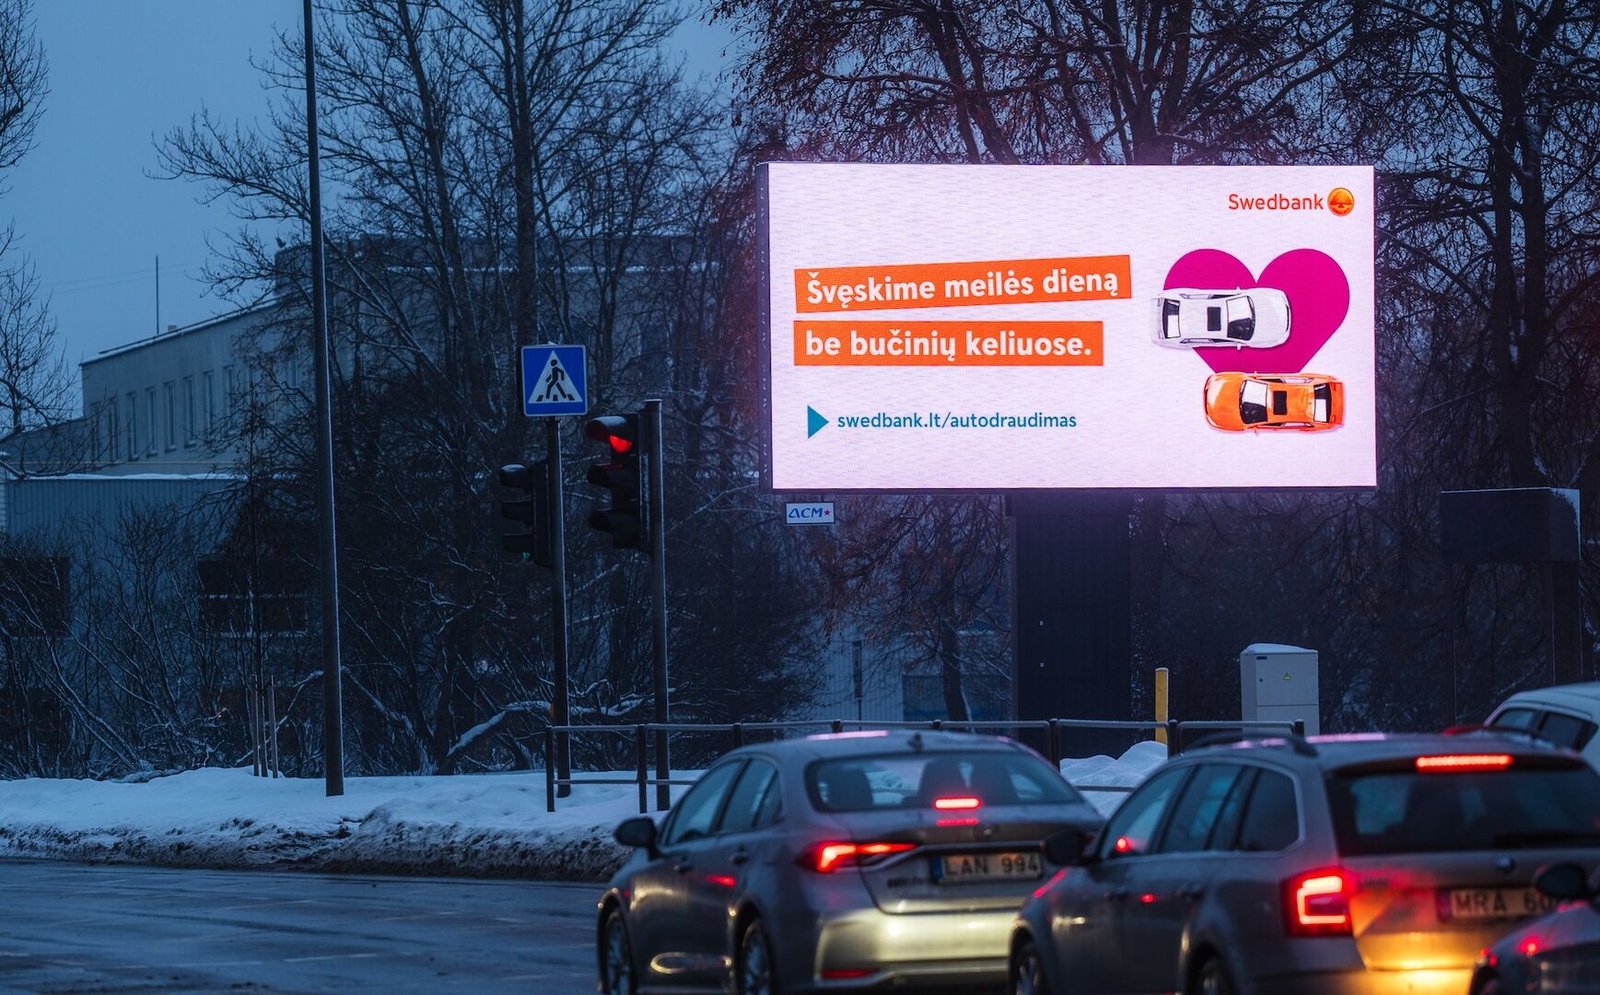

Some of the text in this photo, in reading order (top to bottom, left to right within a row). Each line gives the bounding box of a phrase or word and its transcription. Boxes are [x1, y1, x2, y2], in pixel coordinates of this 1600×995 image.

[1228, 193, 1324, 210] Swedbank
[806, 268, 1119, 309] Švęskime meilės dieną
[805, 328, 1092, 362] be bučinių keliuose.
[837, 411, 1077, 429] swedbank.lt/autodraudimas
[788, 507, 823, 519] ACM
[943, 852, 1039, 876] LAN 994
[1453, 893, 1508, 915] MRA
